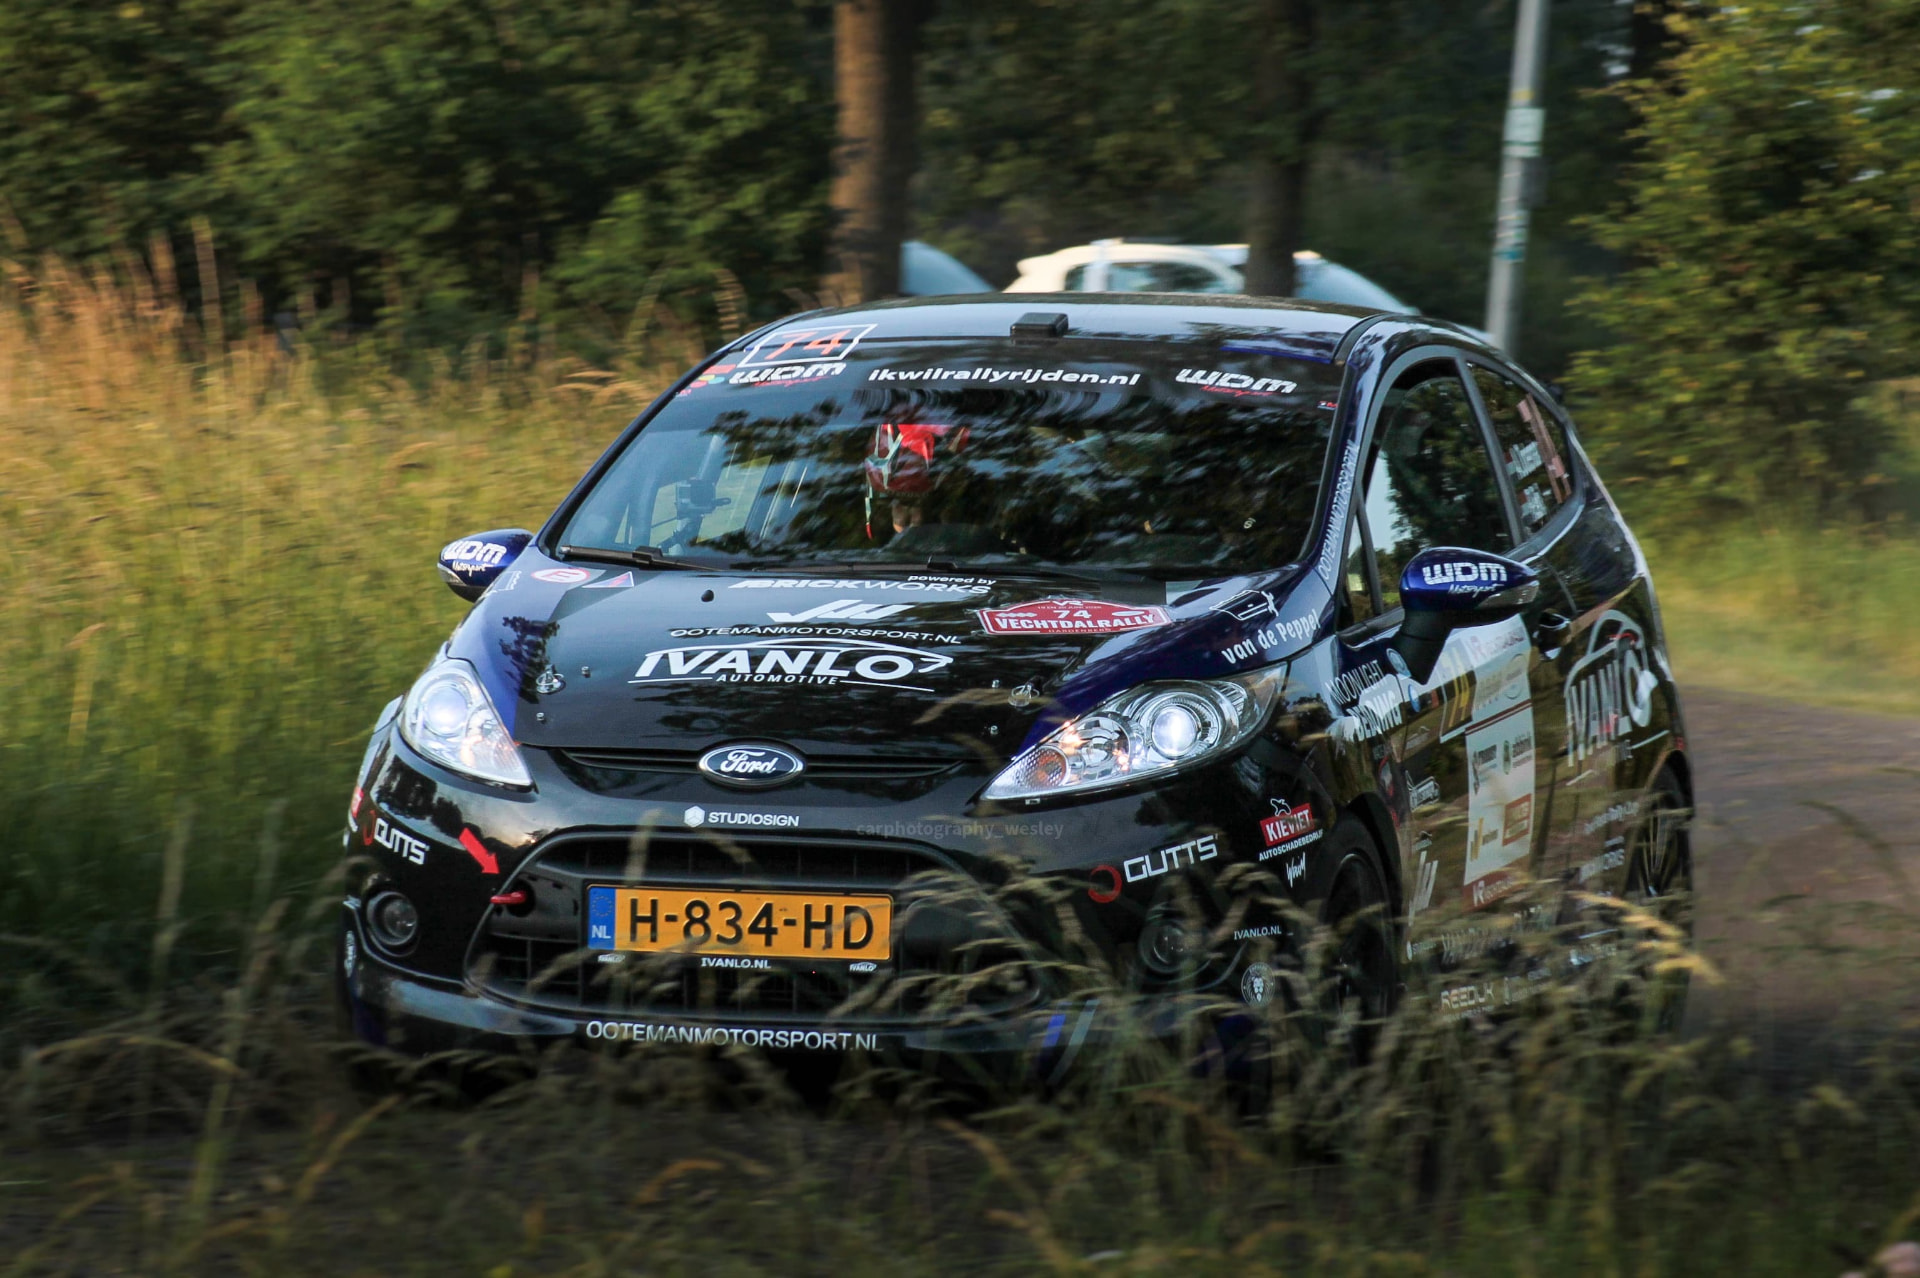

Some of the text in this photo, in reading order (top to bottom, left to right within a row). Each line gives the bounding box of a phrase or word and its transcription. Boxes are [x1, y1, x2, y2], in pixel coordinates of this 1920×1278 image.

[765, 329, 851, 360] 74
[729, 362, 847, 385] WDM
[868, 367, 1141, 386] ikwilrallyrijden.nl
[1175, 368, 1298, 394] WDM
[443, 540, 507, 563] WDM
[907, 574, 997, 587] powered by
[1422, 562, 1508, 585] WDM
[727, 579, 993, 594] BRICKWORKS
[994, 613, 1156, 629] VECHTDALRALLY
[1053, 609, 1091, 619] 74
[670, 627, 963, 645] OOTEMANMOTORSPORT.NL
[1221, 608, 1321, 665] van de Peppel
[633, 649, 918, 680] IVANLO
[716, 673, 839, 685] AUTOMOTIVE
[1325, 659, 1386, 706] MOONLIGHT
[719, 748, 777, 774] Ford
[707, 811, 800, 827] STUDIOSIGN
[1258, 828, 1324, 862] AUTOSCHADEBEDRIJF
[1123, 834, 1218, 883] GUTTS
[591, 924, 612, 940] NL
[629, 897, 874, 950] H-834-HD
[1233, 925, 1282, 941] IVANLO.NL
[701, 957, 772, 970] IVANLO.NL
[585, 1020, 884, 1052] OOTEMANMOTORSPORT.NL
